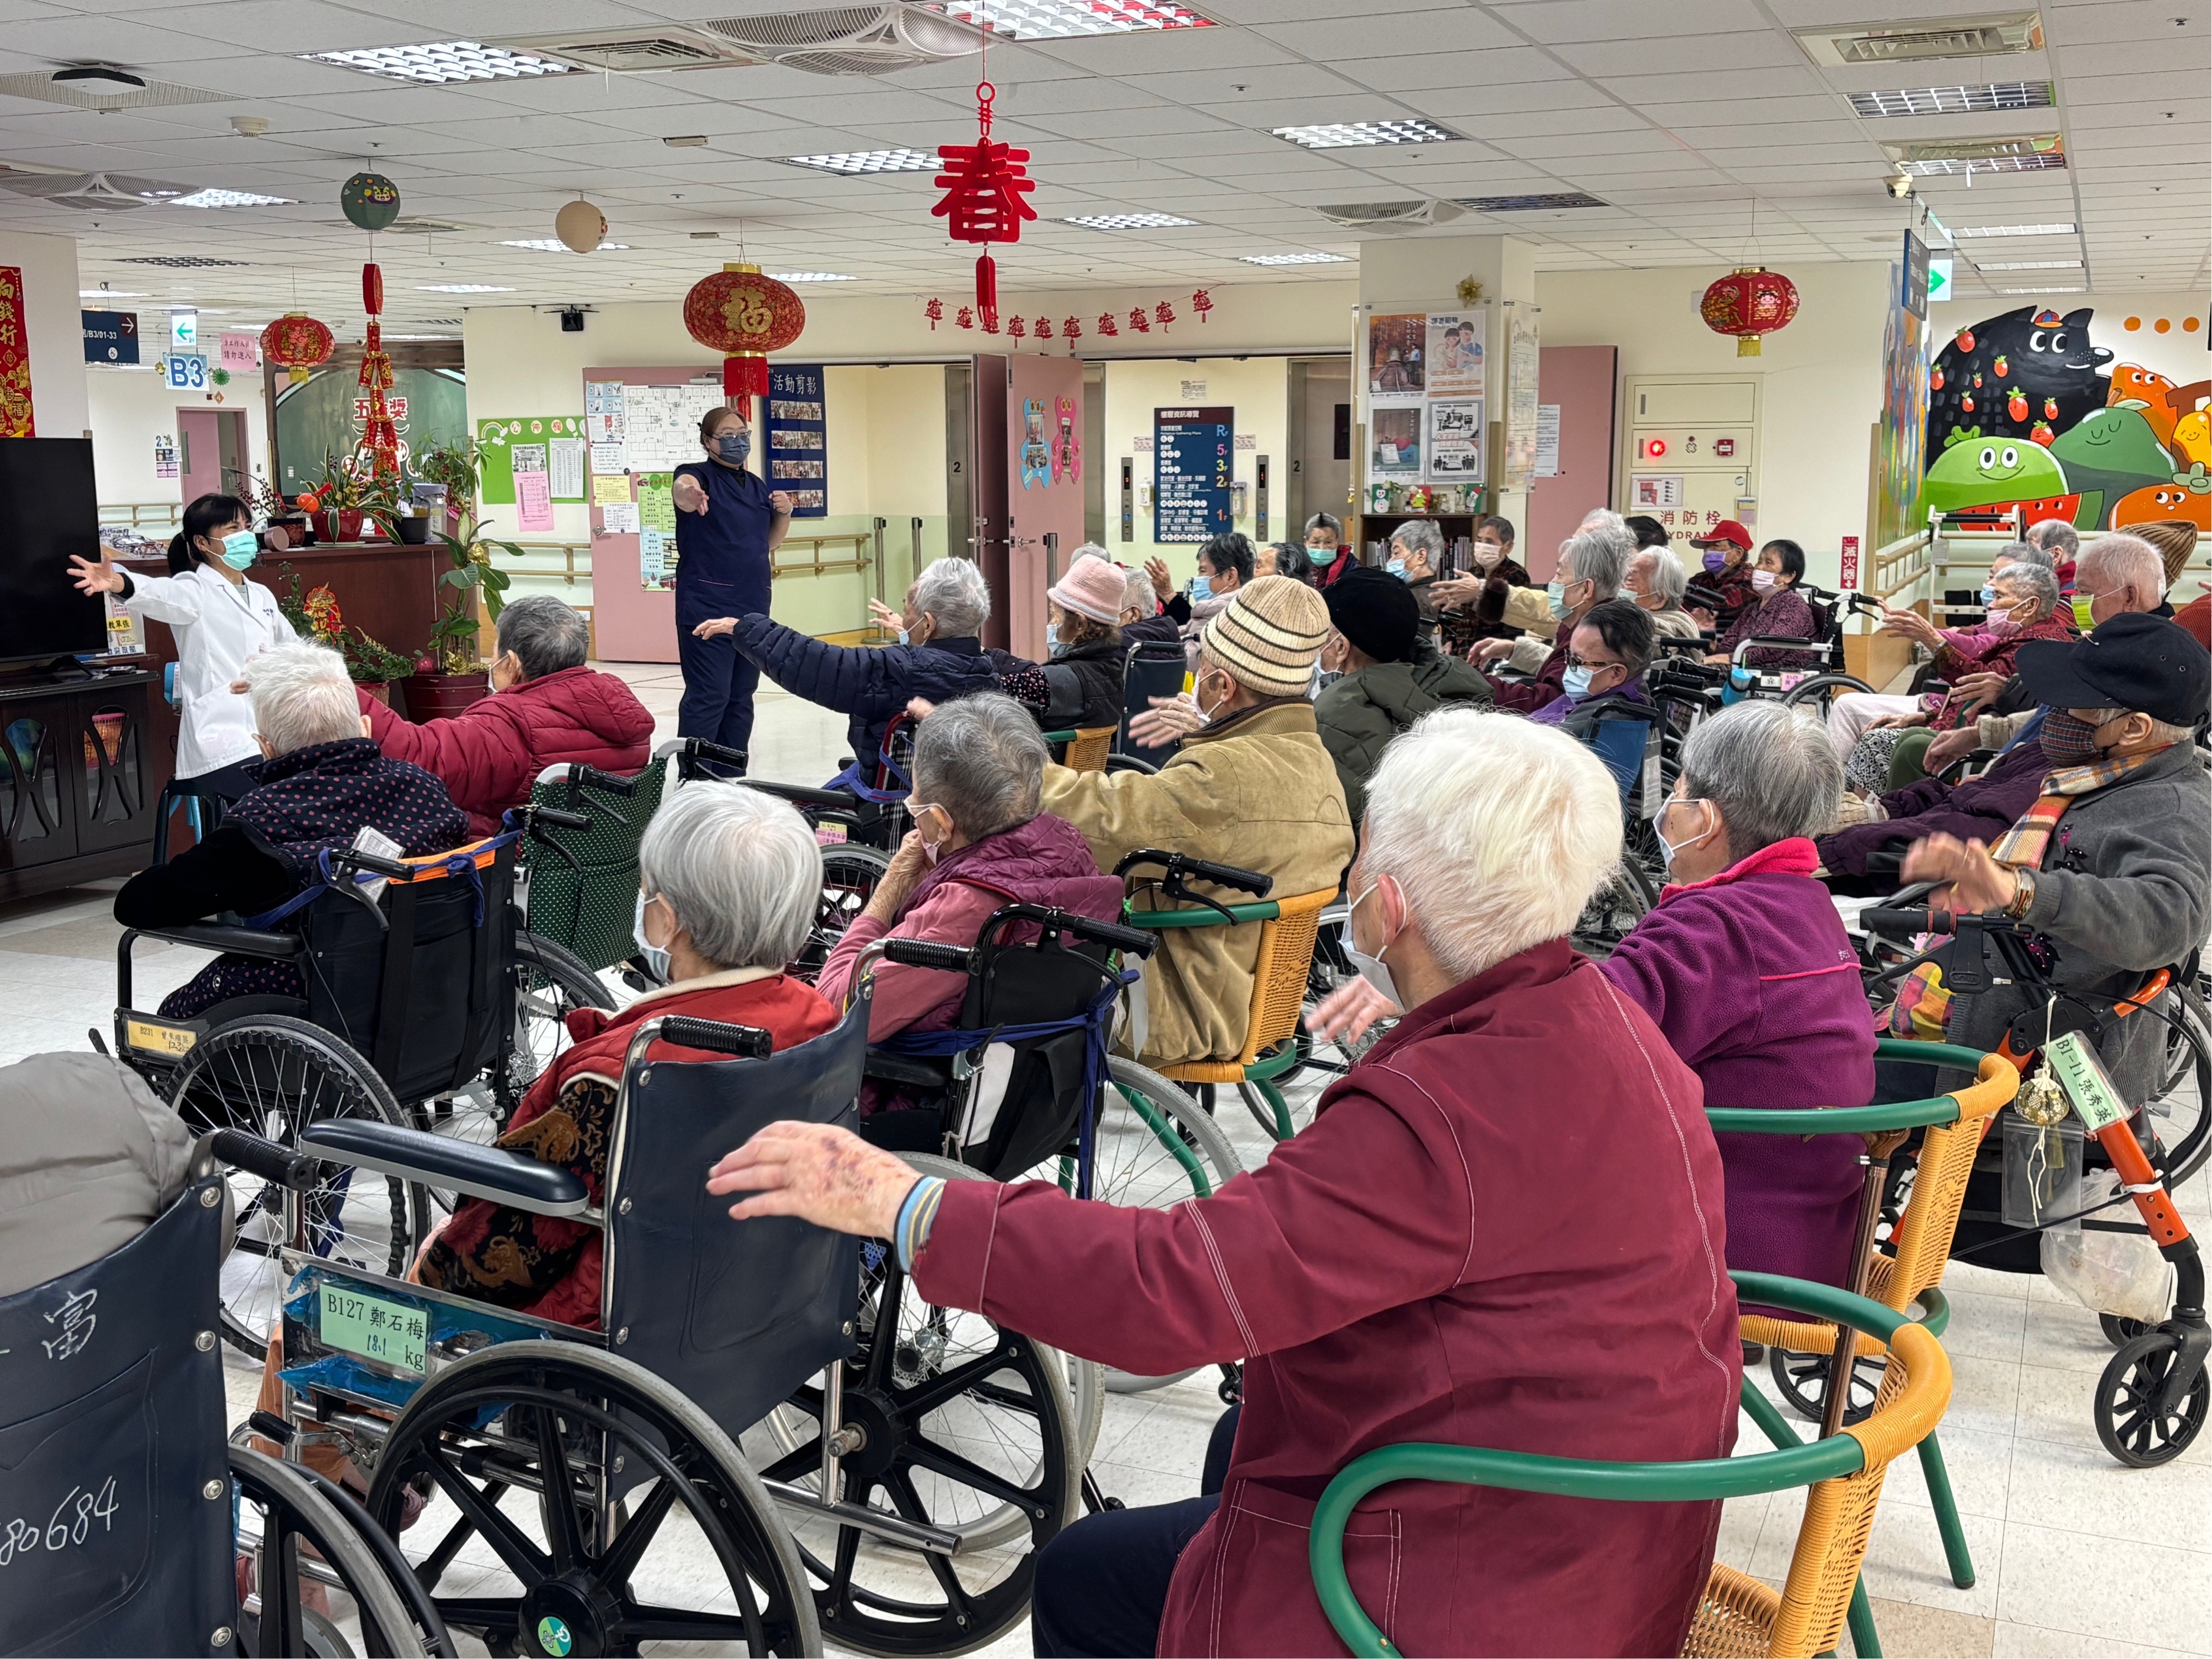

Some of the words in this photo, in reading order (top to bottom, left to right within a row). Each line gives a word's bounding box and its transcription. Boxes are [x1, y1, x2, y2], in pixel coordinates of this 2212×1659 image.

[720, 286, 774, 335] 福
[170, 358, 204, 387] B3
[774, 374, 817, 395] 活動剪影
[354, 398, 408, 421] 五獎
[953, 461, 961, 473] 2
[1293, 460, 1301, 472] 2
[1660, 510, 1721, 525] 消防栓
[1667, 531, 1712, 539] YDRAN
[1844, 546, 1857, 580] 滅火器
[140, 1026, 153, 1036] B231
[2078, 1078, 2113, 1123] 張秀英
[328, 1293, 364, 1321] B127
[370, 1306, 425, 1340] 鄭石梅
[405, 1345, 424, 1372] kg
